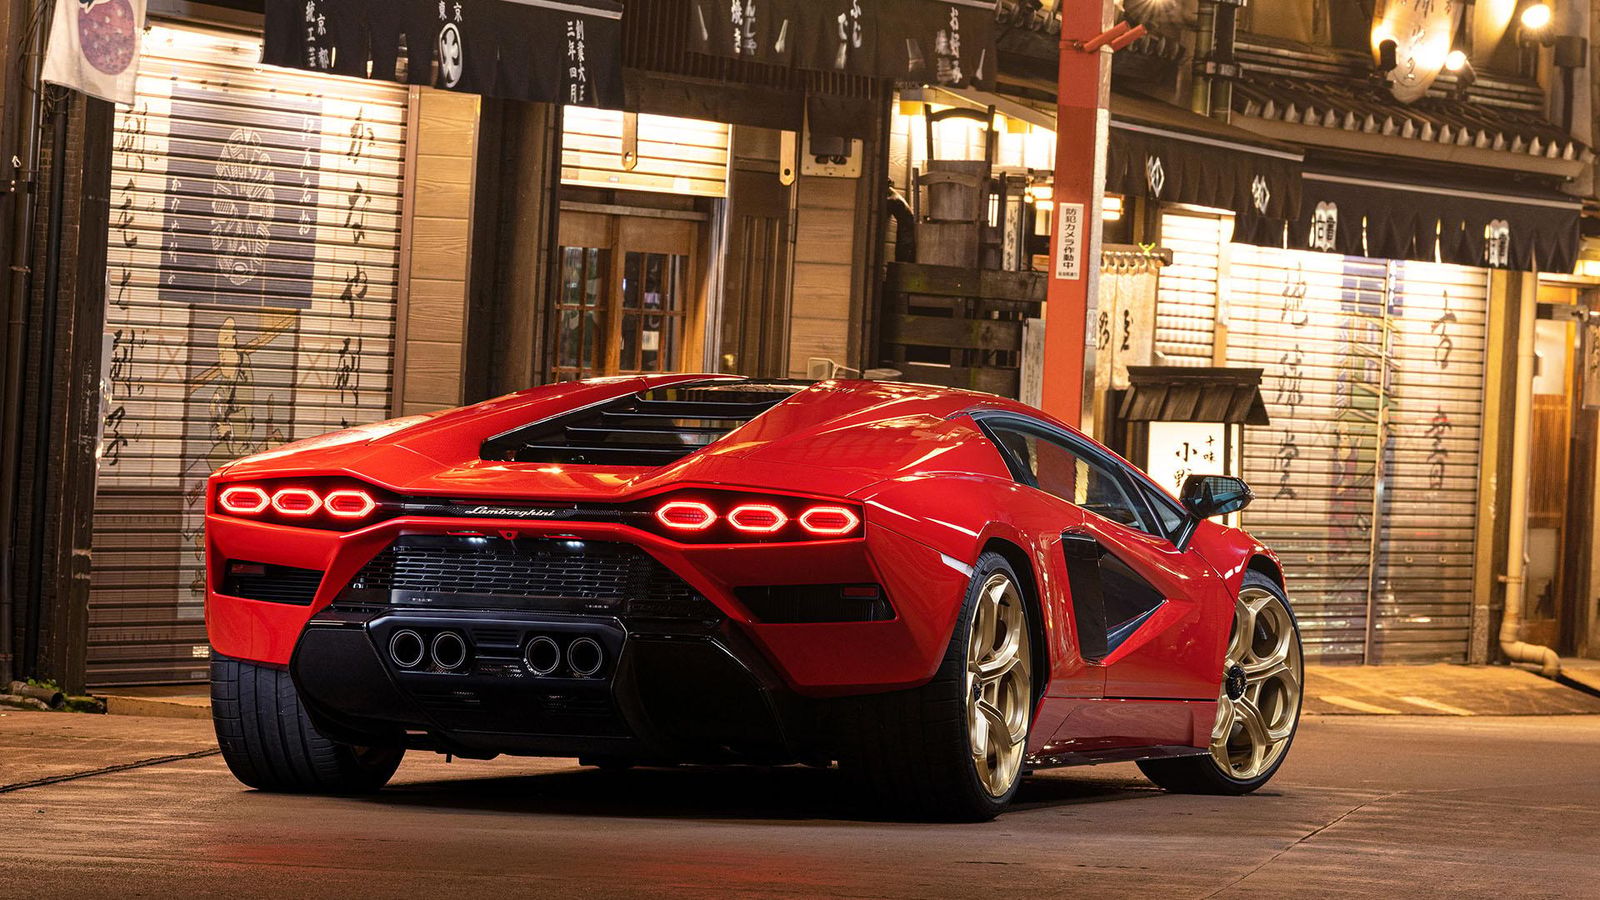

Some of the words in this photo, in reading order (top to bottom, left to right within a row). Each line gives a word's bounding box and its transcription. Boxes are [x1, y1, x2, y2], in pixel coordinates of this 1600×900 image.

[317, 0, 329, 69] 京都
[439, 1, 463, 21] 東京
[567, 21, 577, 104] 三年四月
[576, 19, 586, 101] 創業大正
[334, 104, 375, 429] かなや刷
[1063, 208, 1077, 269] 防犯カメラ作動中
[1203, 434, 1216, 464] 十味
[465, 506, 556, 517] Lamborghini
